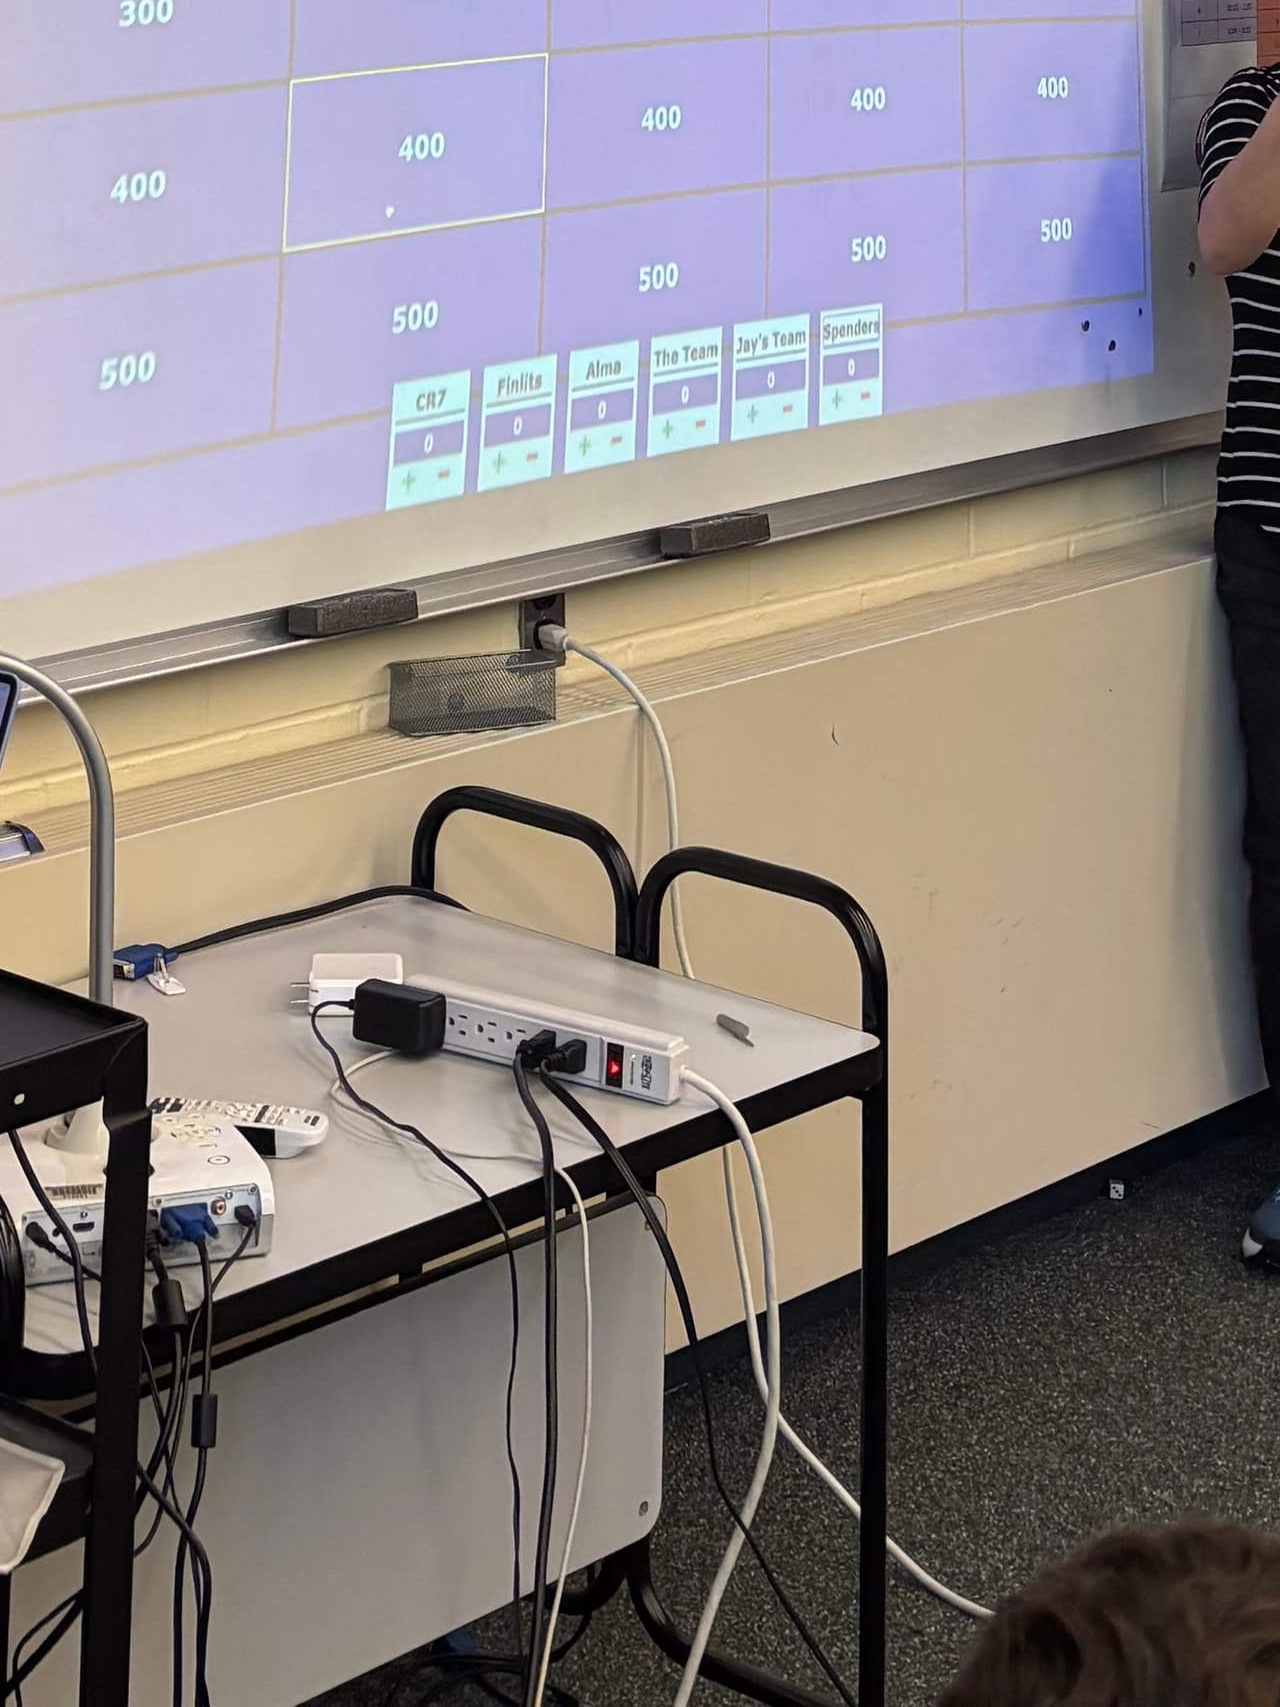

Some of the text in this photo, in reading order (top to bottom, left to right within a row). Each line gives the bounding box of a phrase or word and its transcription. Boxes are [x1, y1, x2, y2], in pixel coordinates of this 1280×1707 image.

[850, 86, 886, 111] 400
[1037, 76, 1069, 99] 400
[641, 105, 681, 132] 400
[398, 132, 445, 162] 400
[110, 170, 166, 204] 400
[1040, 217, 1072, 243] 500
[851, 234, 887, 262] 500
[638, 262, 679, 292] 500
[392, 300, 439, 334] 500
[823, 318, 880, 341] Spenders
[736, 329, 807, 355] Jay's Team
[654, 343, 719, 368] The Team
[847, 358, 856, 376] 0
[99, 351, 156, 390] 500
[585, 358, 622, 381] Alma
[767, 371, 775, 389] 0
[496, 372, 543, 397] Finlits
[681, 385, 690, 404] 0
[415, 388, 447, 412] CR7
[598, 400, 607, 420] 0
[513, 416, 523, 436] 0
[424, 433, 434, 454] 0
